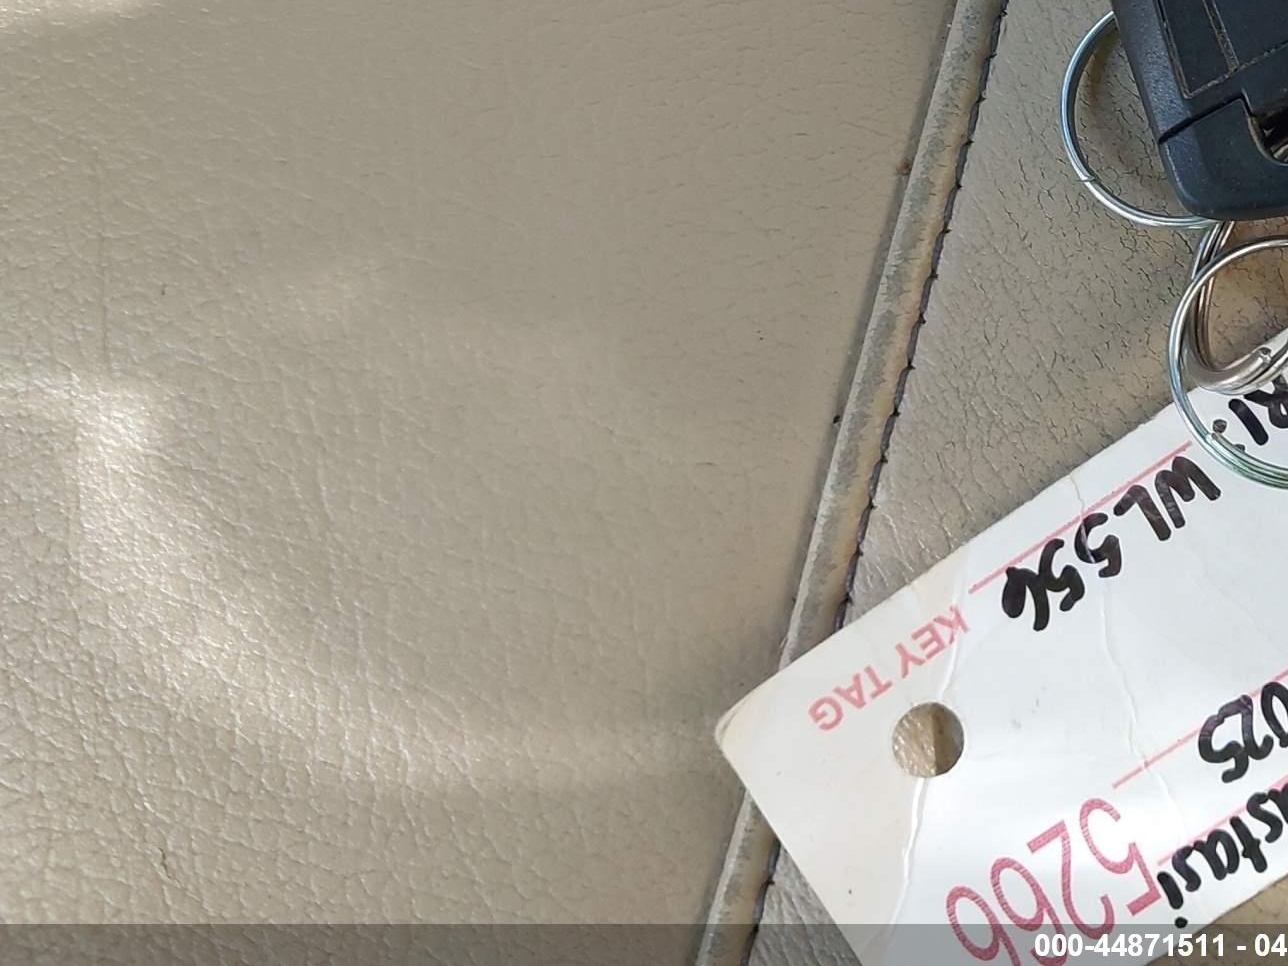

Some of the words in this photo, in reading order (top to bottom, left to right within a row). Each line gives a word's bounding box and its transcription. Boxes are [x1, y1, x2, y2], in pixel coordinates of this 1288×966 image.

[895, 604, 970, 679] KEY
[807, 664, 893, 731] TAG
[945, 797, 1162, 966] 5266
